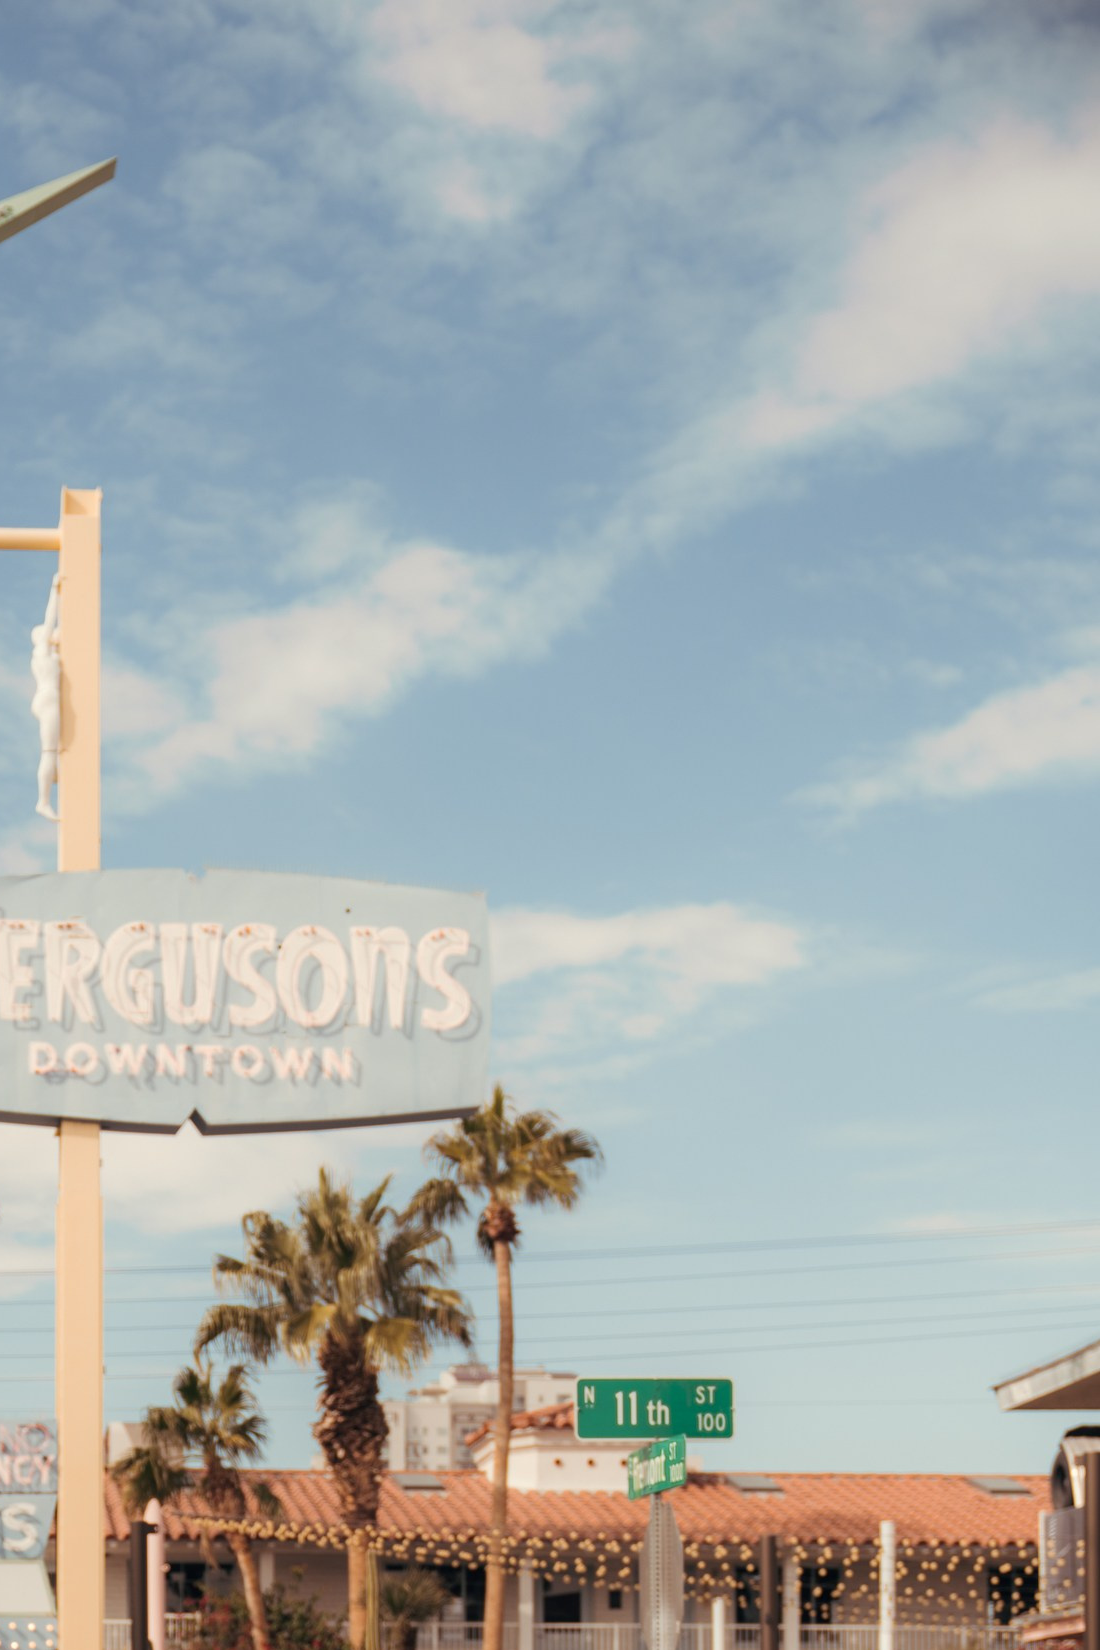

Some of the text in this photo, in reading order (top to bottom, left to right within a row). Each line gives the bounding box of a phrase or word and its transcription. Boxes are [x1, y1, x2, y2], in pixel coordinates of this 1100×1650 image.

[27, 1040, 354, 1081] DOWNTOWN
[583, 1385, 717, 1426] N 11th ST
[697, 1412, 726, 1432] 100
[669, 1441, 677, 1461] ST
